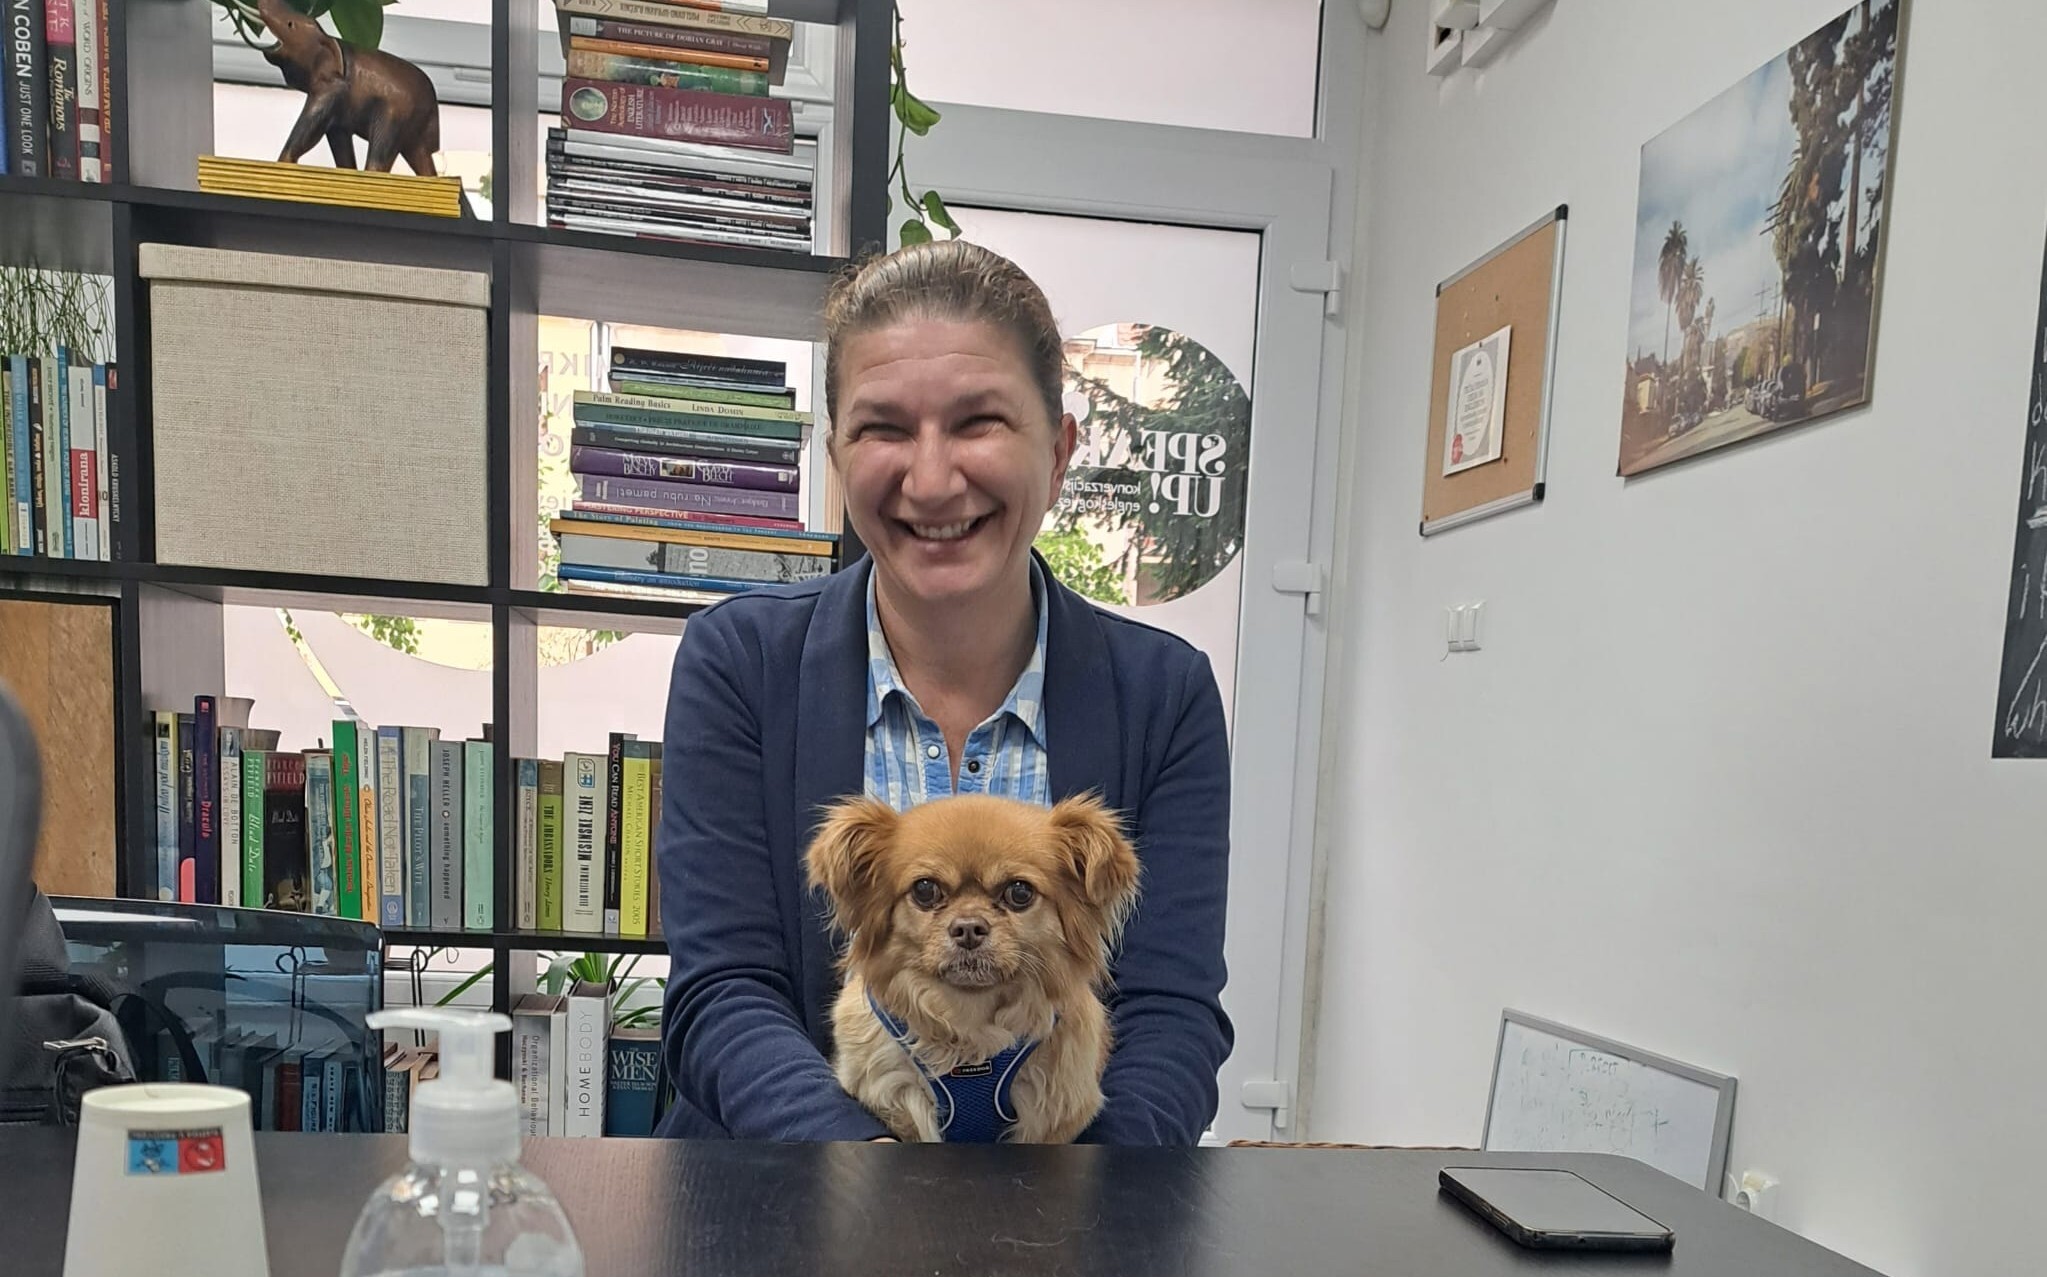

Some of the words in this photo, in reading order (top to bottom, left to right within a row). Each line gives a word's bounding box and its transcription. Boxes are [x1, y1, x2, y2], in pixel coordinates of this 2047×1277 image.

[14, 15, 32, 77] COBEN
[82, 21, 91, 53] WORD
[616, 26, 633, 36] THE
[634, 28, 664, 39] PICTURE
[665, 31, 675, 40] OF
[676, 32, 704, 44] DORIAN
[705, 35, 725, 46] GRAY
[83, 57, 92, 95] ORIGINS
[19, 81, 31, 104] JUST
[53, 56, 67, 132] Romanovs
[20, 107, 32, 126] ONE
[627, 94, 635, 123] ENGLISH
[635, 88, 643, 130] LITERATURE
[21, 129, 33, 155] LOOK
[3, 390, 11, 407] THE
[592, 393, 613, 404] Palm
[614, 395, 646, 409] Reading
[647, 397, 672, 410] Basics
[691, 402, 715, 414] LINDA
[4, 408, 14, 458] INCREDIBLE
[111, 453, 119, 477] ASKOLD
[624, 463, 658, 476] BINCHY
[79, 452, 90, 517] klonirana
[614, 485, 658, 499] pameti
[662, 490, 690, 505] rubu
[634, 505, 689, 520] PERSPECTIVE
[694, 492, 712, 507] Na
[573, 510, 589, 521] The
[590, 512, 613, 523] Story
[613, 514, 624, 524] of
[625, 515, 659, 527] Painting
[442, 749, 450, 777] JOSEPH
[611, 743, 621, 763] YOU
[247, 758, 255, 799] FYFIELD
[267, 771, 306, 785] FYFIELD
[382, 758, 397, 784] The
[611, 763, 620, 784] CAN
[636, 773, 645, 792] BEST
[231, 794, 238, 804] DE
[382, 787, 397, 823] Road
[442, 780, 450, 807] HELLER
[610, 785, 619, 808] READ
[626, 785, 634, 819] MICHAEL
[200, 800, 213, 838] Dracula
[414, 806, 424, 826] THE
[543, 805, 554, 820] THE
[634, 793, 645, 838] AMERICAN
[247, 813, 261, 843] Blind
[383, 826, 397, 851] Not
[442, 822, 451, 860] something
[414, 827, 424, 861] PILOT'S
[543, 823, 555, 874] AMBASSADORS
[633, 839, 643, 868] SHORT
[247, 845, 261, 873] Date
[384, 853, 399, 893] Taken
[414, 862, 424, 886] WIFE
[443, 863, 451, 899] happened
[632, 869, 641, 901] STORIES
[544, 876, 553, 898] Henry
[632, 905, 641, 925] 2005
[530, 1035, 540, 1093] Organizational
[578, 1010, 593, 1117] HOMEBODY
[611, 1051, 658, 1066] WISE
[611, 1066, 657, 1081] MEN
[529, 1096, 540, 1137] Behaviour
